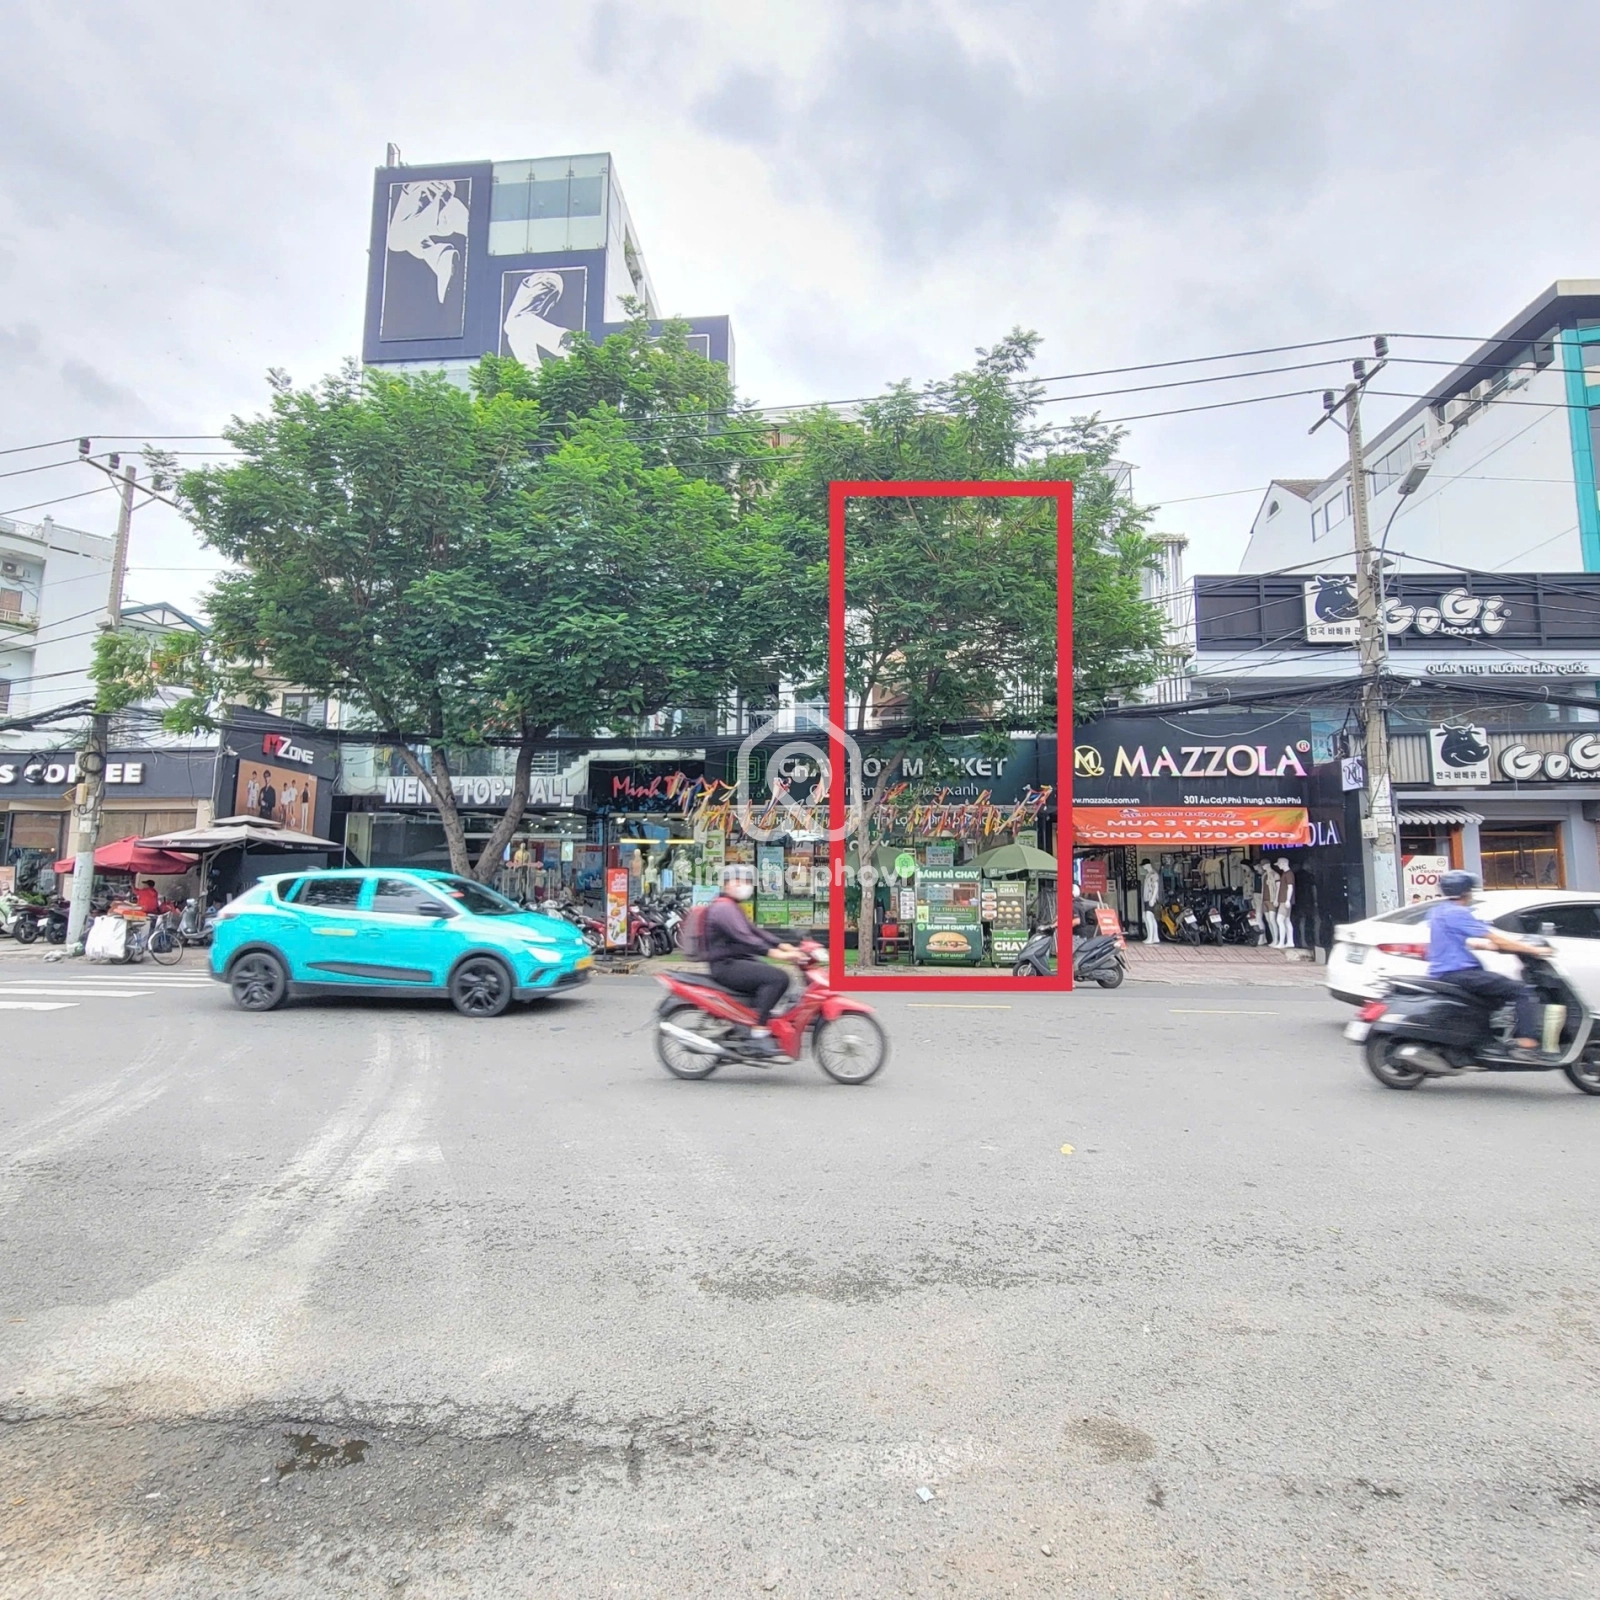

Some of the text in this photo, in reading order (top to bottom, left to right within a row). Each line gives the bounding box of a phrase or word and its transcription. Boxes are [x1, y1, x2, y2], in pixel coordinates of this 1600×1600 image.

[1309, 627, 1325, 636] 한국
[1441, 623, 1481, 635] house
[1113, 745, 1307, 777] MAZZOLA
[24, 763, 142, 783] COEE
[1436, 771, 1451, 779] 한국
[1454, 771, 1477, 779] 바베큐
[462, 777, 574, 805] TOP-ALL
[1183, 795, 1199, 804] 301
[1147, 830, 1188, 839] GIÁ
[994, 941, 1028, 951] CHAY
